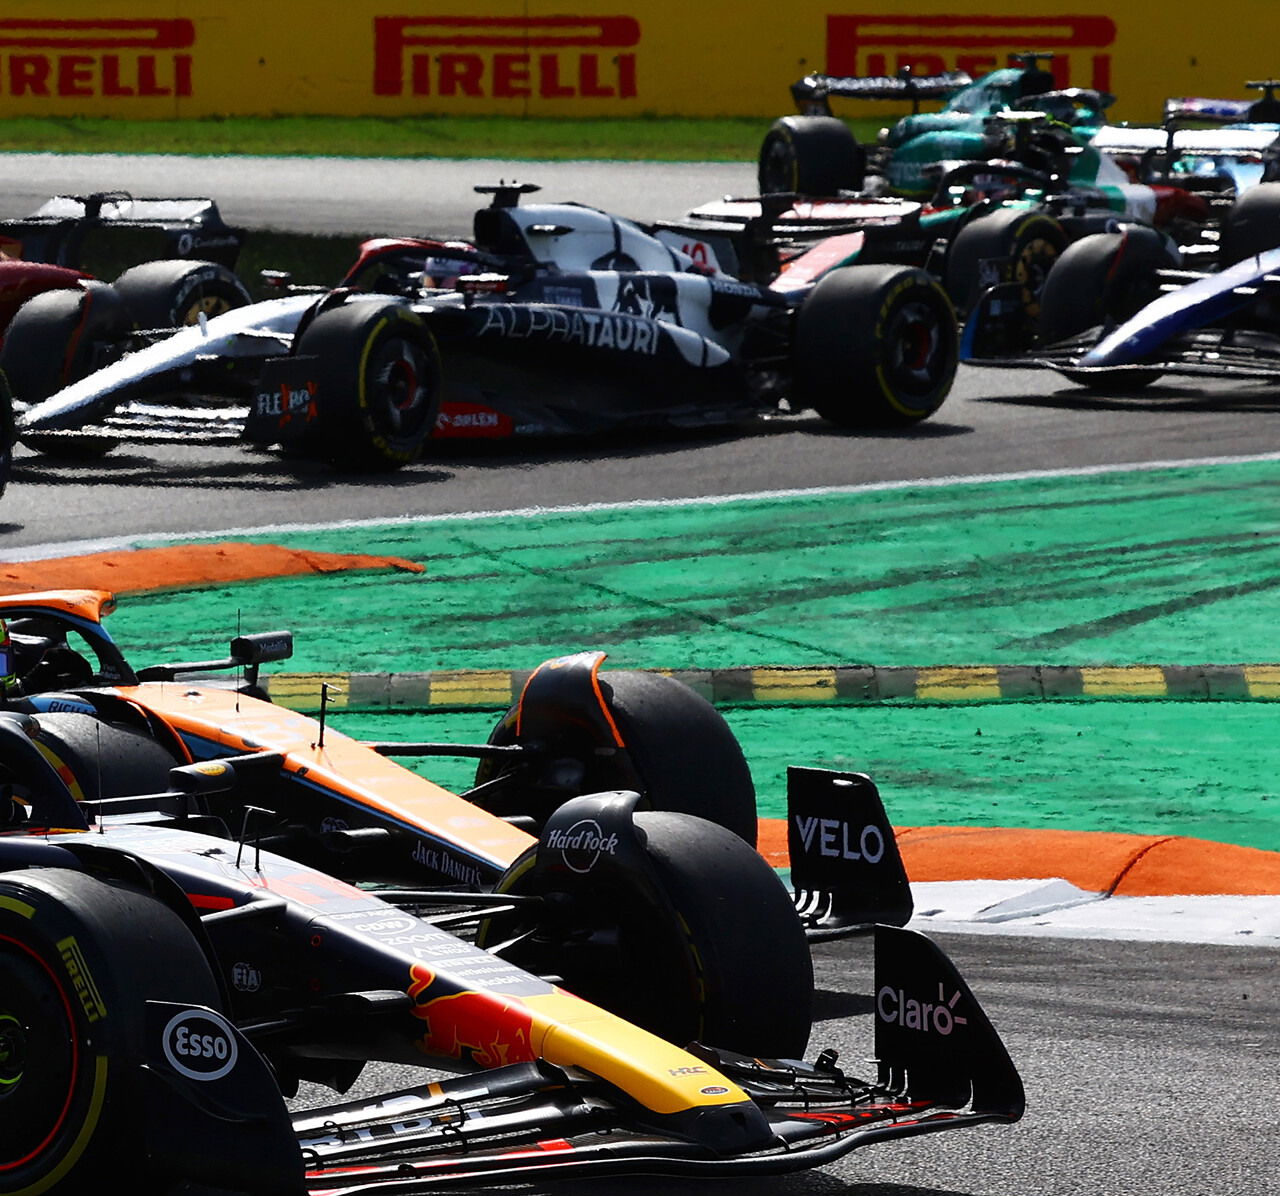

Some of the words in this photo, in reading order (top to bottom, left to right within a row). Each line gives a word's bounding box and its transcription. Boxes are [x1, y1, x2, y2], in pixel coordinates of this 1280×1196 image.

[374, 15, 641, 99] PIRELLI
[411, 840, 440, 871] JACK
[546, 828, 589, 849] Hard
[583, 829, 619, 855] Rock
[795, 814, 884, 864] VELO
[54, 935, 109, 1024] PIRELLI
[876, 985, 955, 1036] Claro
